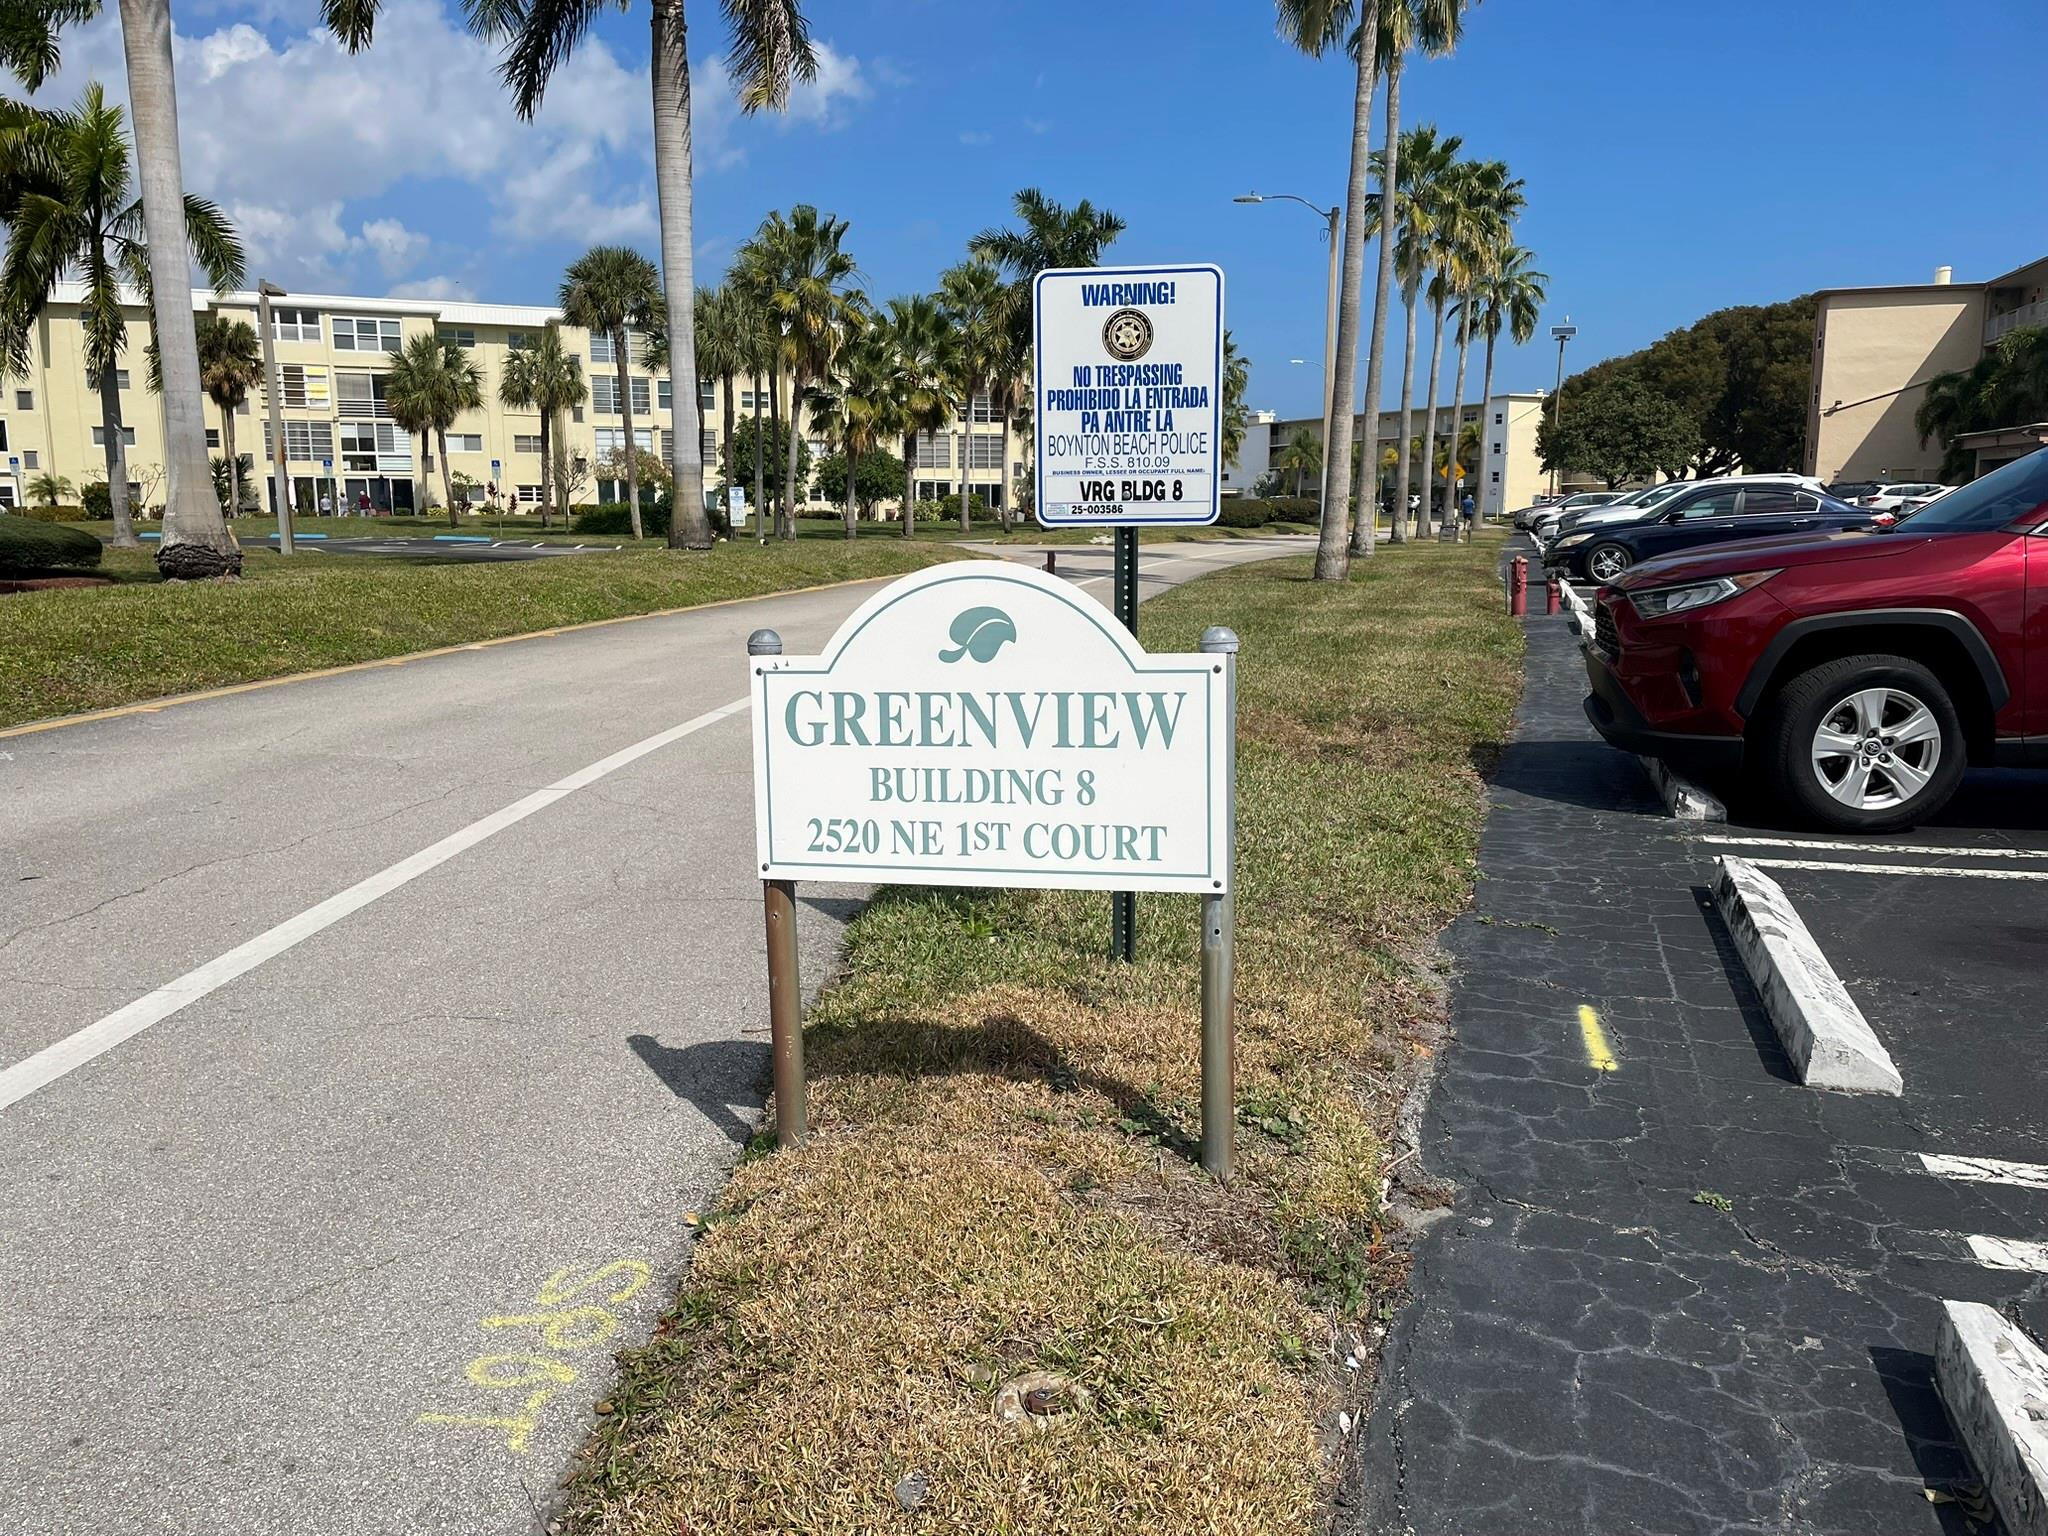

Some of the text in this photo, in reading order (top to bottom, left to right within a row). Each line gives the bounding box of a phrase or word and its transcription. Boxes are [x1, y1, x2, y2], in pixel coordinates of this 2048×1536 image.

[1081, 281, 1176, 307] WARNING!
[1073, 363, 1182, 388] NO TRESPASSING
[1047, 386, 1209, 411] PROHIBIDO LA ENTRADA
[1081, 409, 1174, 433] PA ANTRE LA
[1048, 432, 1208, 457] BOYNTON BEACH POLICE
[1085, 455, 1170, 469] F.S.S. 810.09
[1079, 479, 1183, 502] VRG BLDG 8
[1071, 504, 1123, 514] 25-003586
[785, 690, 1187, 750] GREENVIEW
[870, 767, 1096, 806] BUILDING 8
[806, 817, 1168, 861] 2520 NE 1ST COURT
